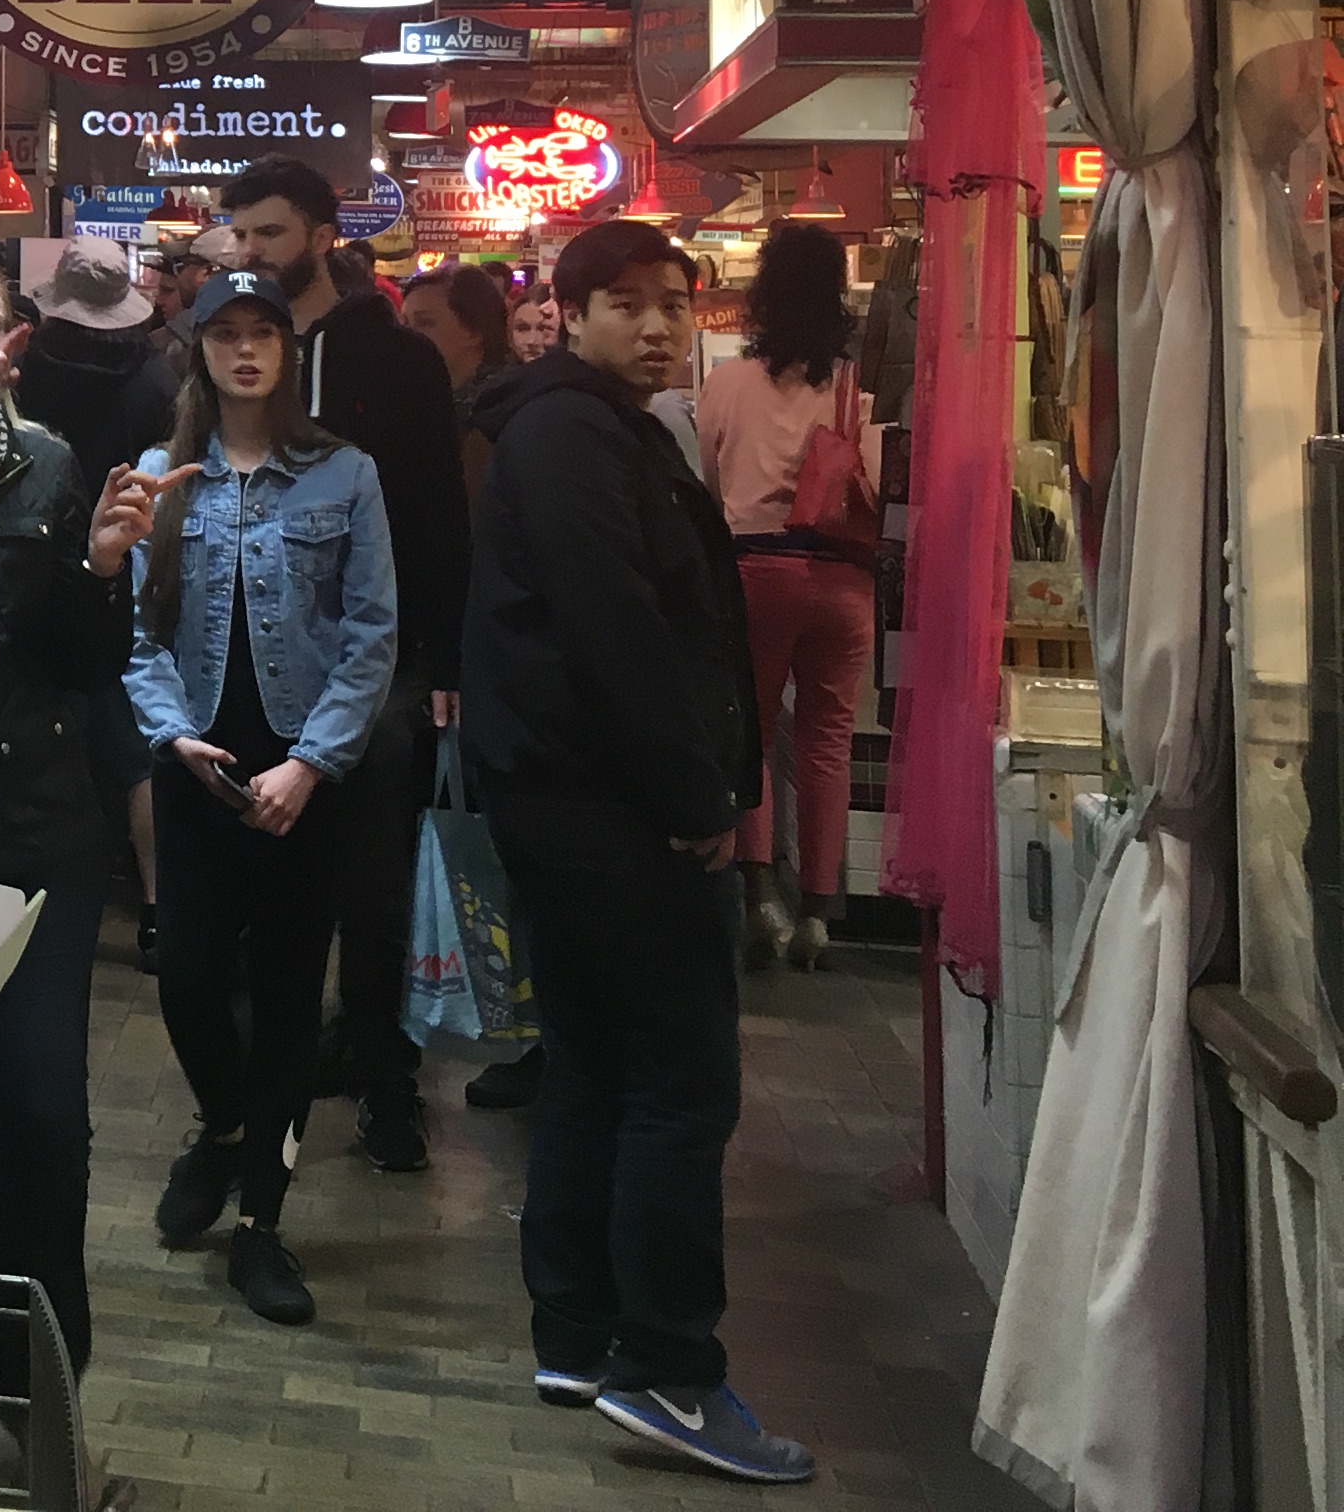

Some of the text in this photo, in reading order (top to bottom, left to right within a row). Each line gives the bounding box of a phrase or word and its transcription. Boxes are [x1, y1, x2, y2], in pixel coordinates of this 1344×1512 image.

[459, 18, 472, 34] B
[445, 34, 523, 49] AVENUE
[20, 30, 243, 79] SINCE 1954
[212, 74, 265, 89] fresh
[82, 103, 345, 138] condiment.
[487, 176, 597, 208] LOBSTERS
[229, 272, 257, 294] T
